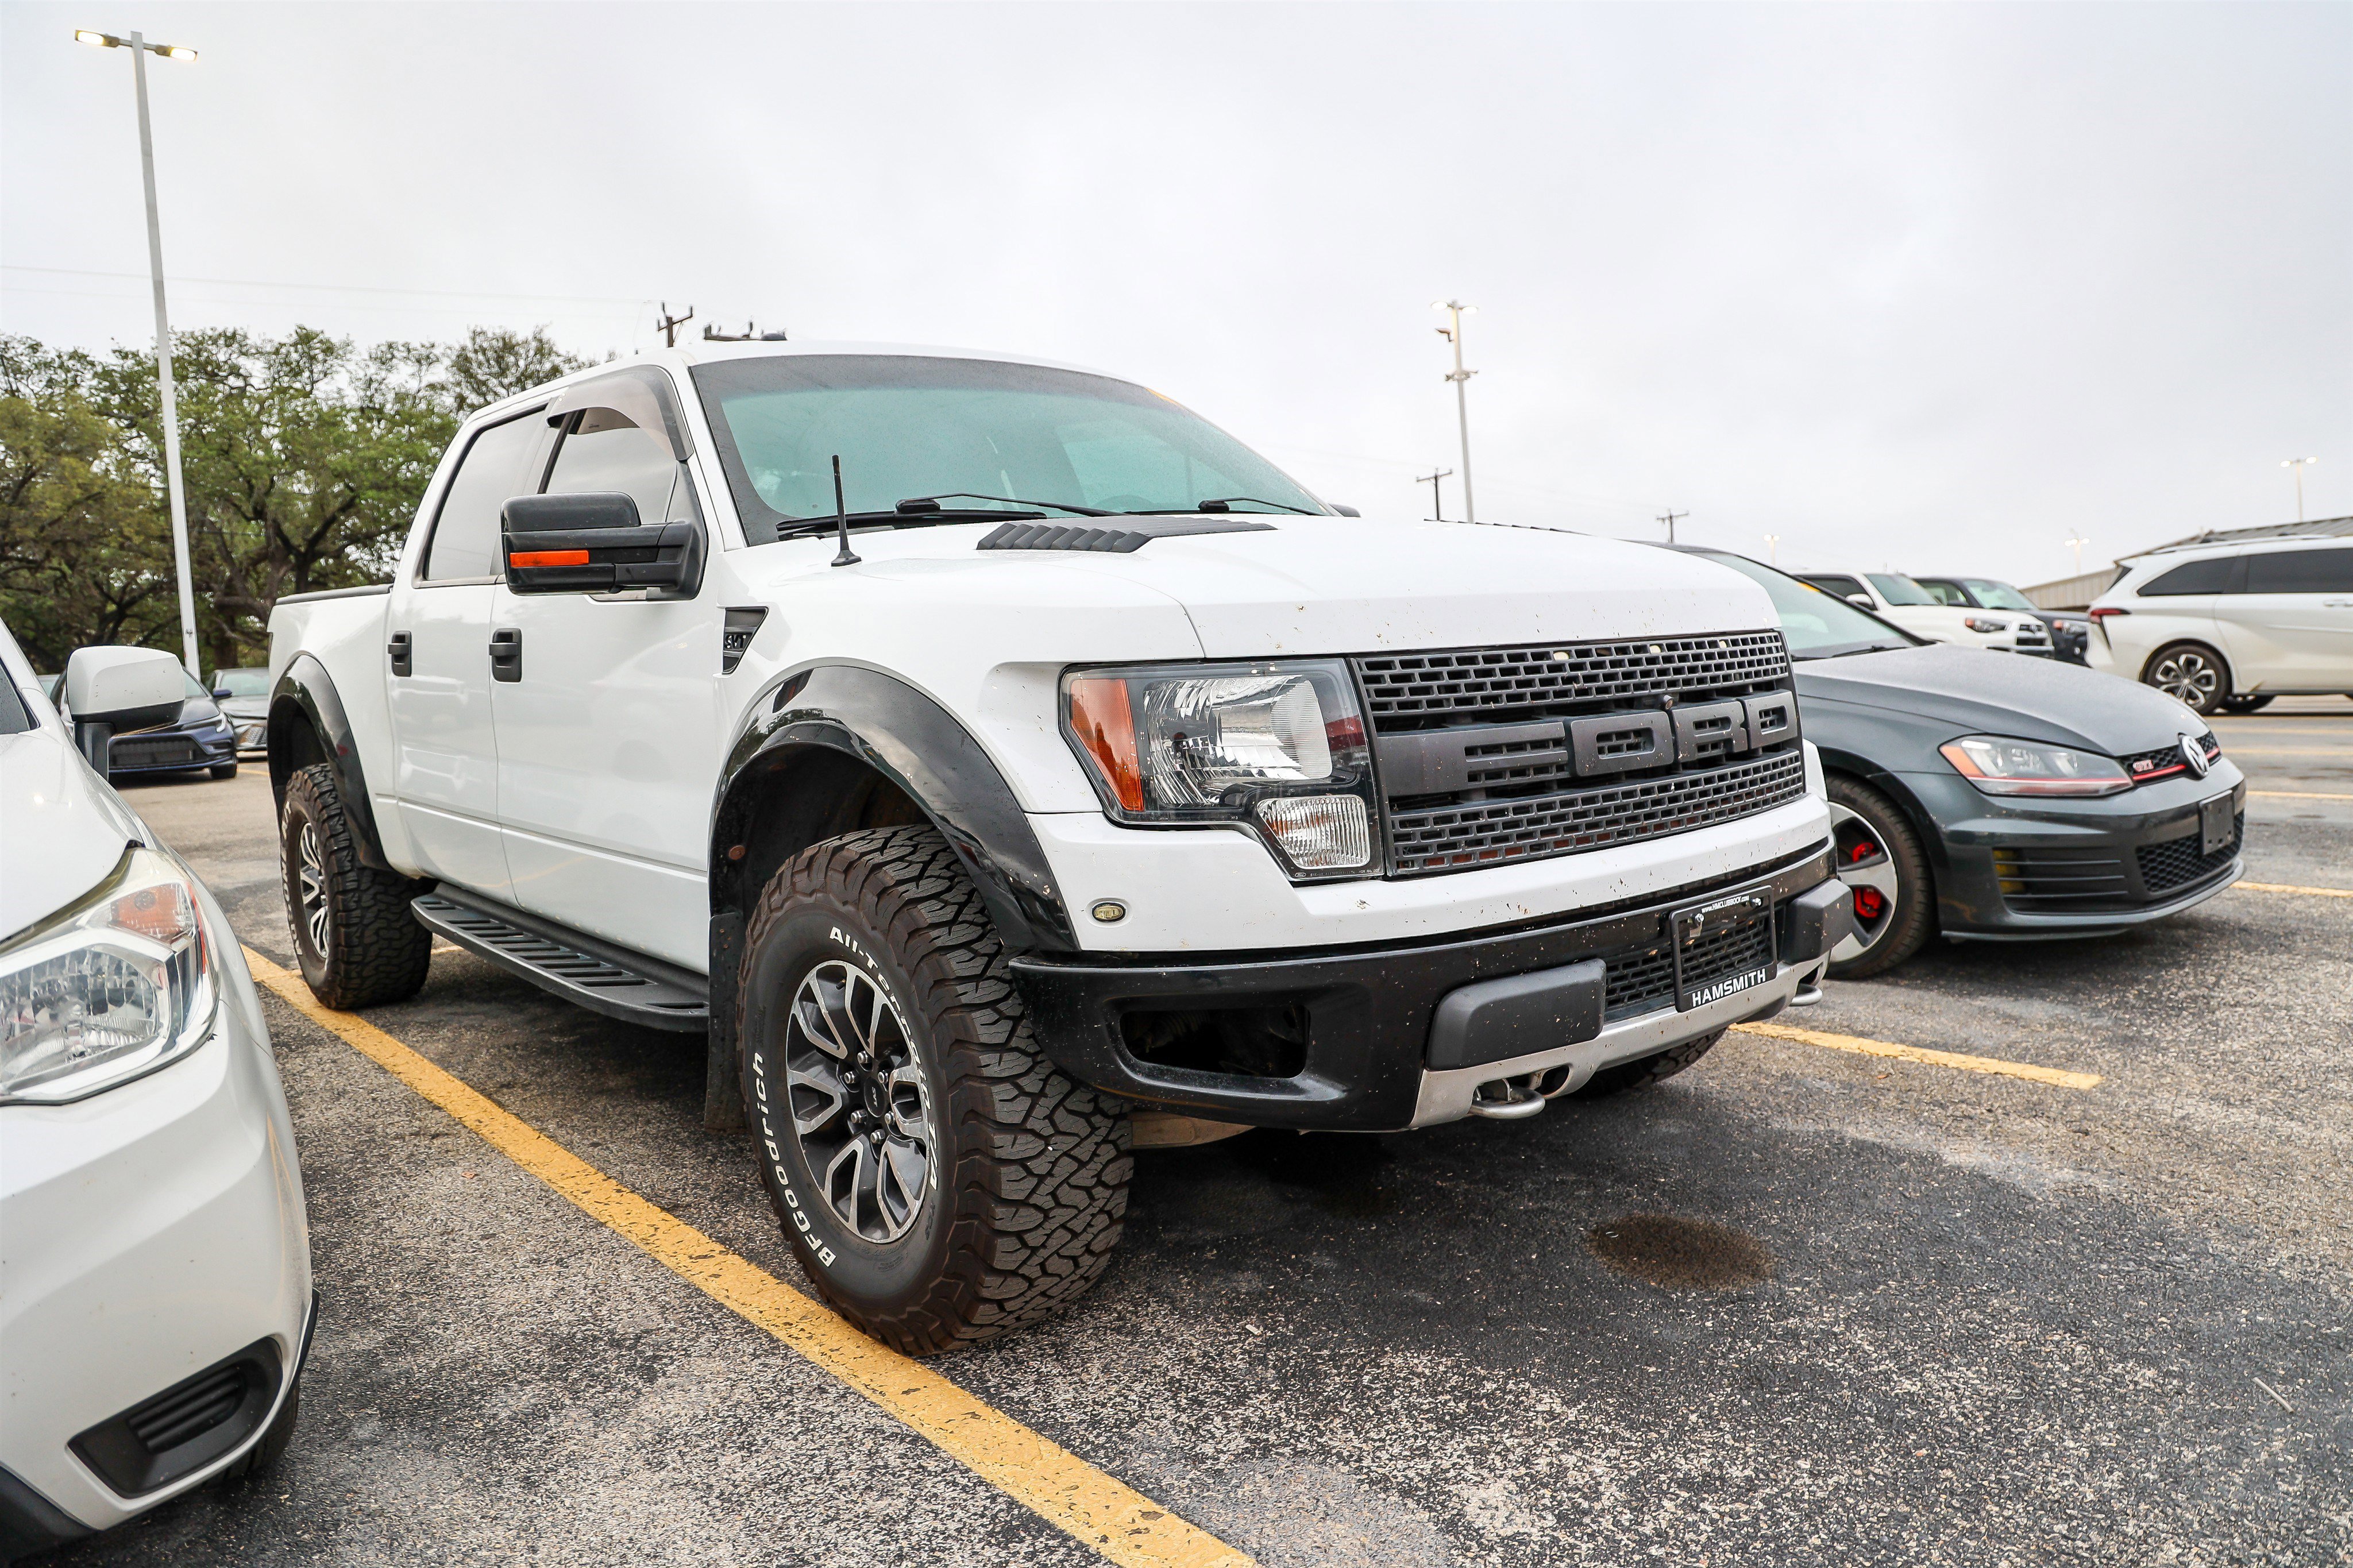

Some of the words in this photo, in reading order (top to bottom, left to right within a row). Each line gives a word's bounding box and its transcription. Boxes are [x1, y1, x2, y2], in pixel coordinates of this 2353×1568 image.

[1378, 690, 1798, 796] FORD
[830, 926, 931, 1110] All-Terrain
[1692, 968, 1765, 1007] HAMSMITH
[753, 1052, 836, 1267] BFGoodrich
